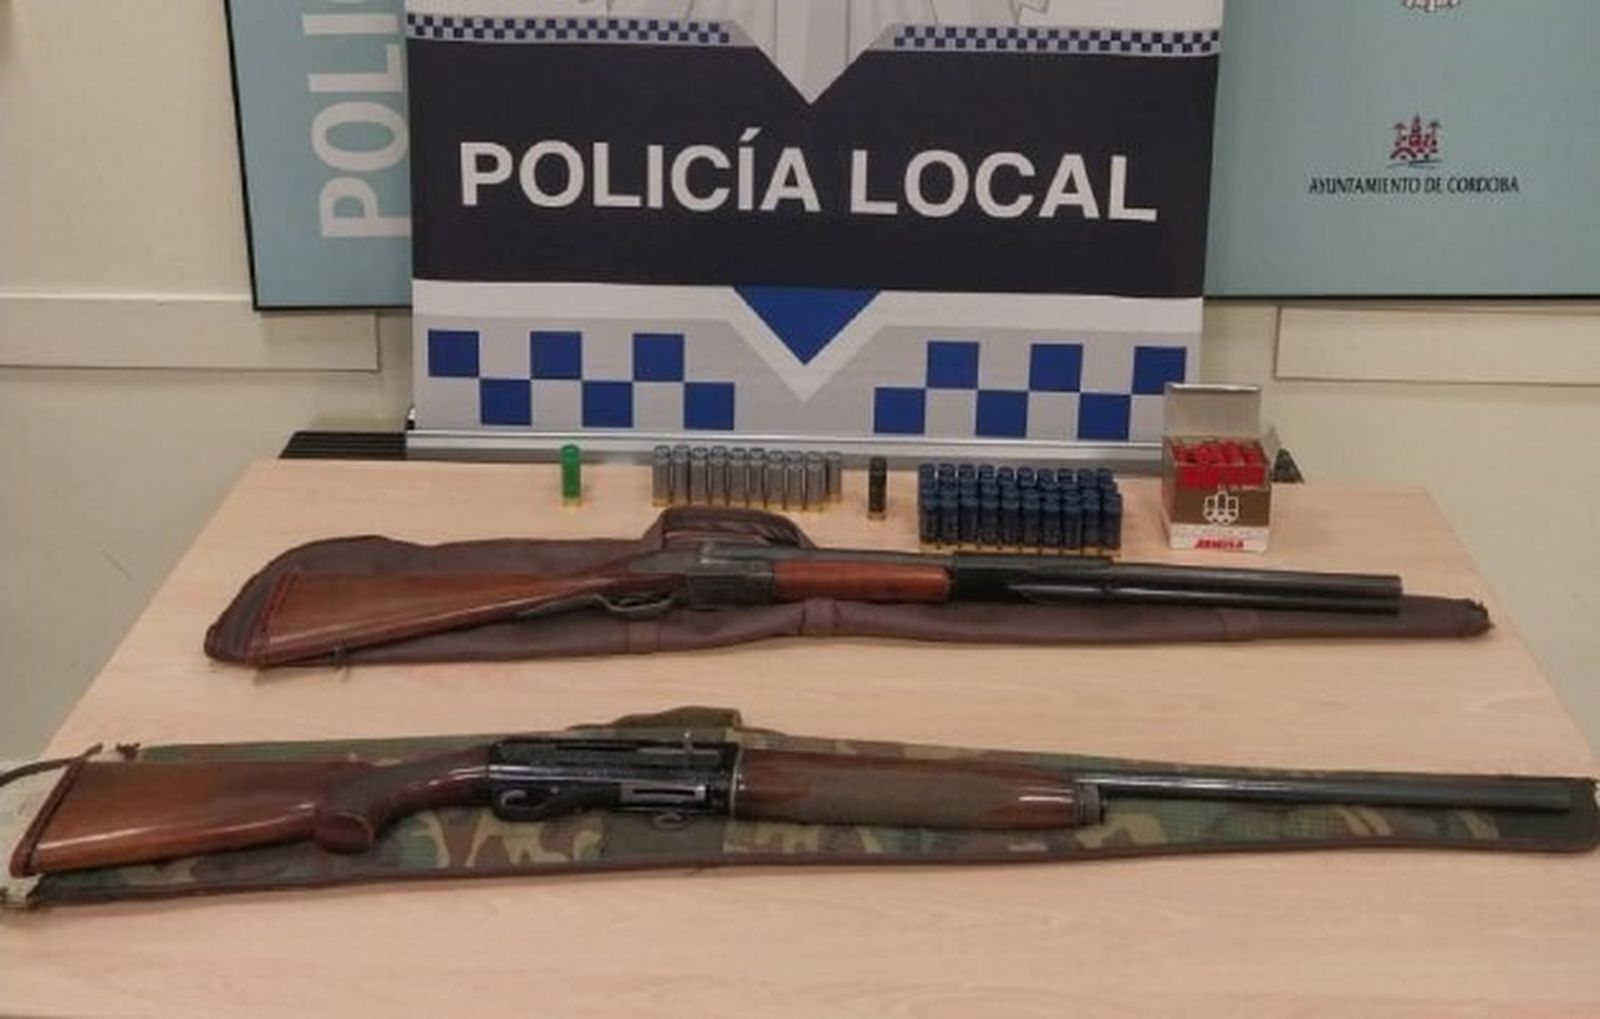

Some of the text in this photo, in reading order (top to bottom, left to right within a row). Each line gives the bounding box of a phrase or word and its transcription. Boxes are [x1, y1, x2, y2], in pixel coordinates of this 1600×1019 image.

[302, 0, 411, 237] POLI
[460, 127, 1157, 221] POLICÍA LOCAL
[1309, 177, 1420, 194] AYUNTAMIENTO
[1424, 177, 1443, 194] DE
